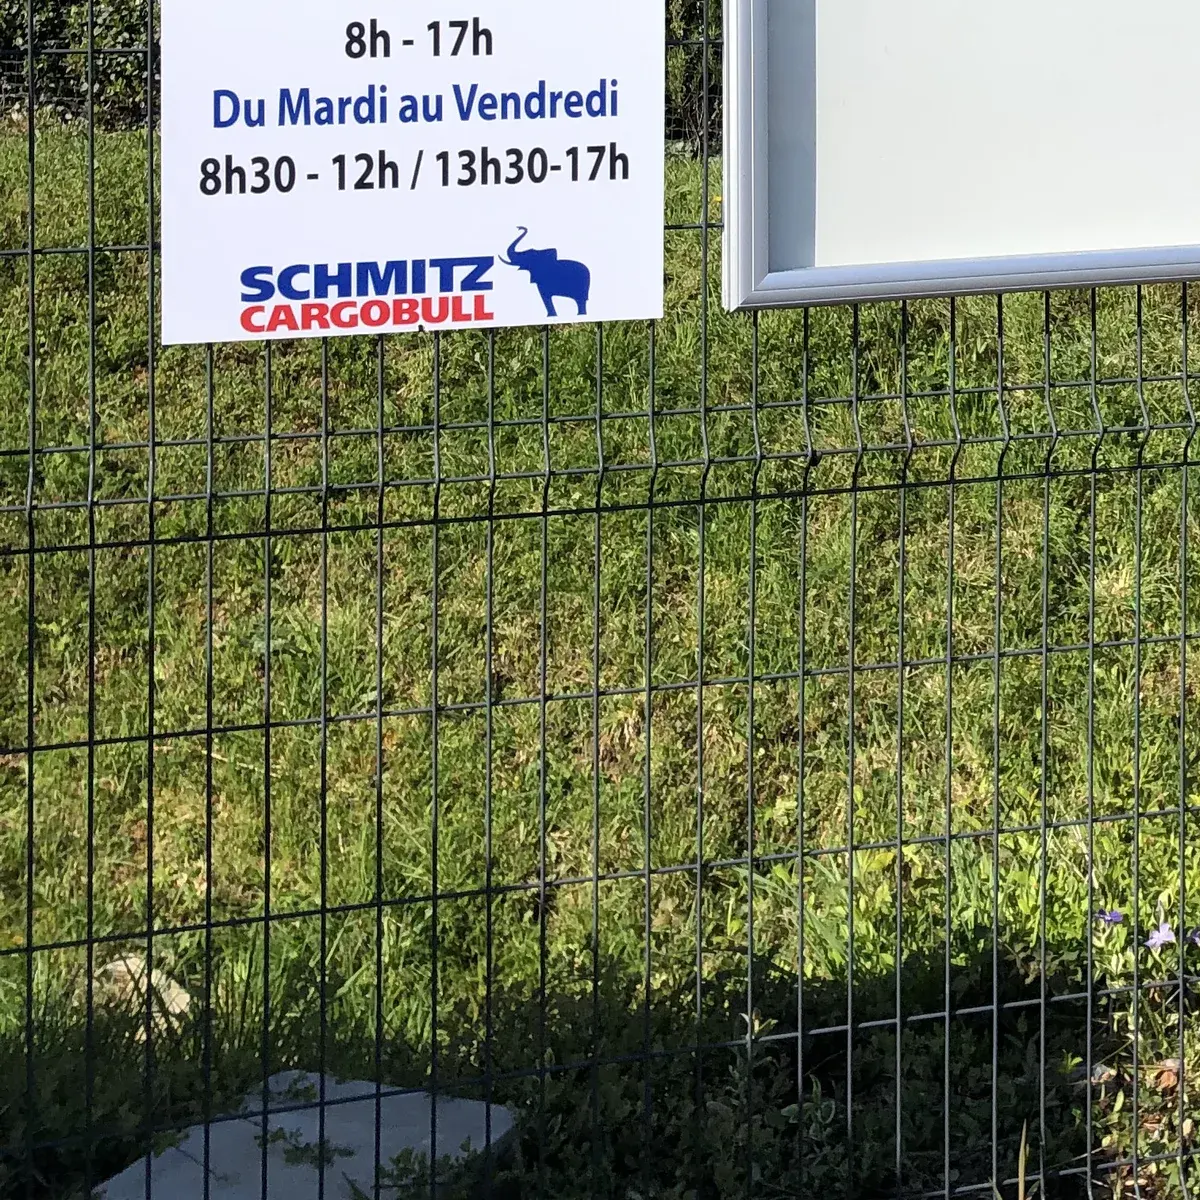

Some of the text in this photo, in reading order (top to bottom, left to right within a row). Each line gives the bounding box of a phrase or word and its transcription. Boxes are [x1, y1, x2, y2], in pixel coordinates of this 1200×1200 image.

[344, 16, 494, 59] 8h - 17h
[212, 78, 619, 129] Du Mardi au Vendredi
[199, 142, 630, 196] 8h30 - 12h / 13h30-17h
[240, 255, 495, 302] SCHMITZ
[239, 294, 494, 333] CARGOBULL
